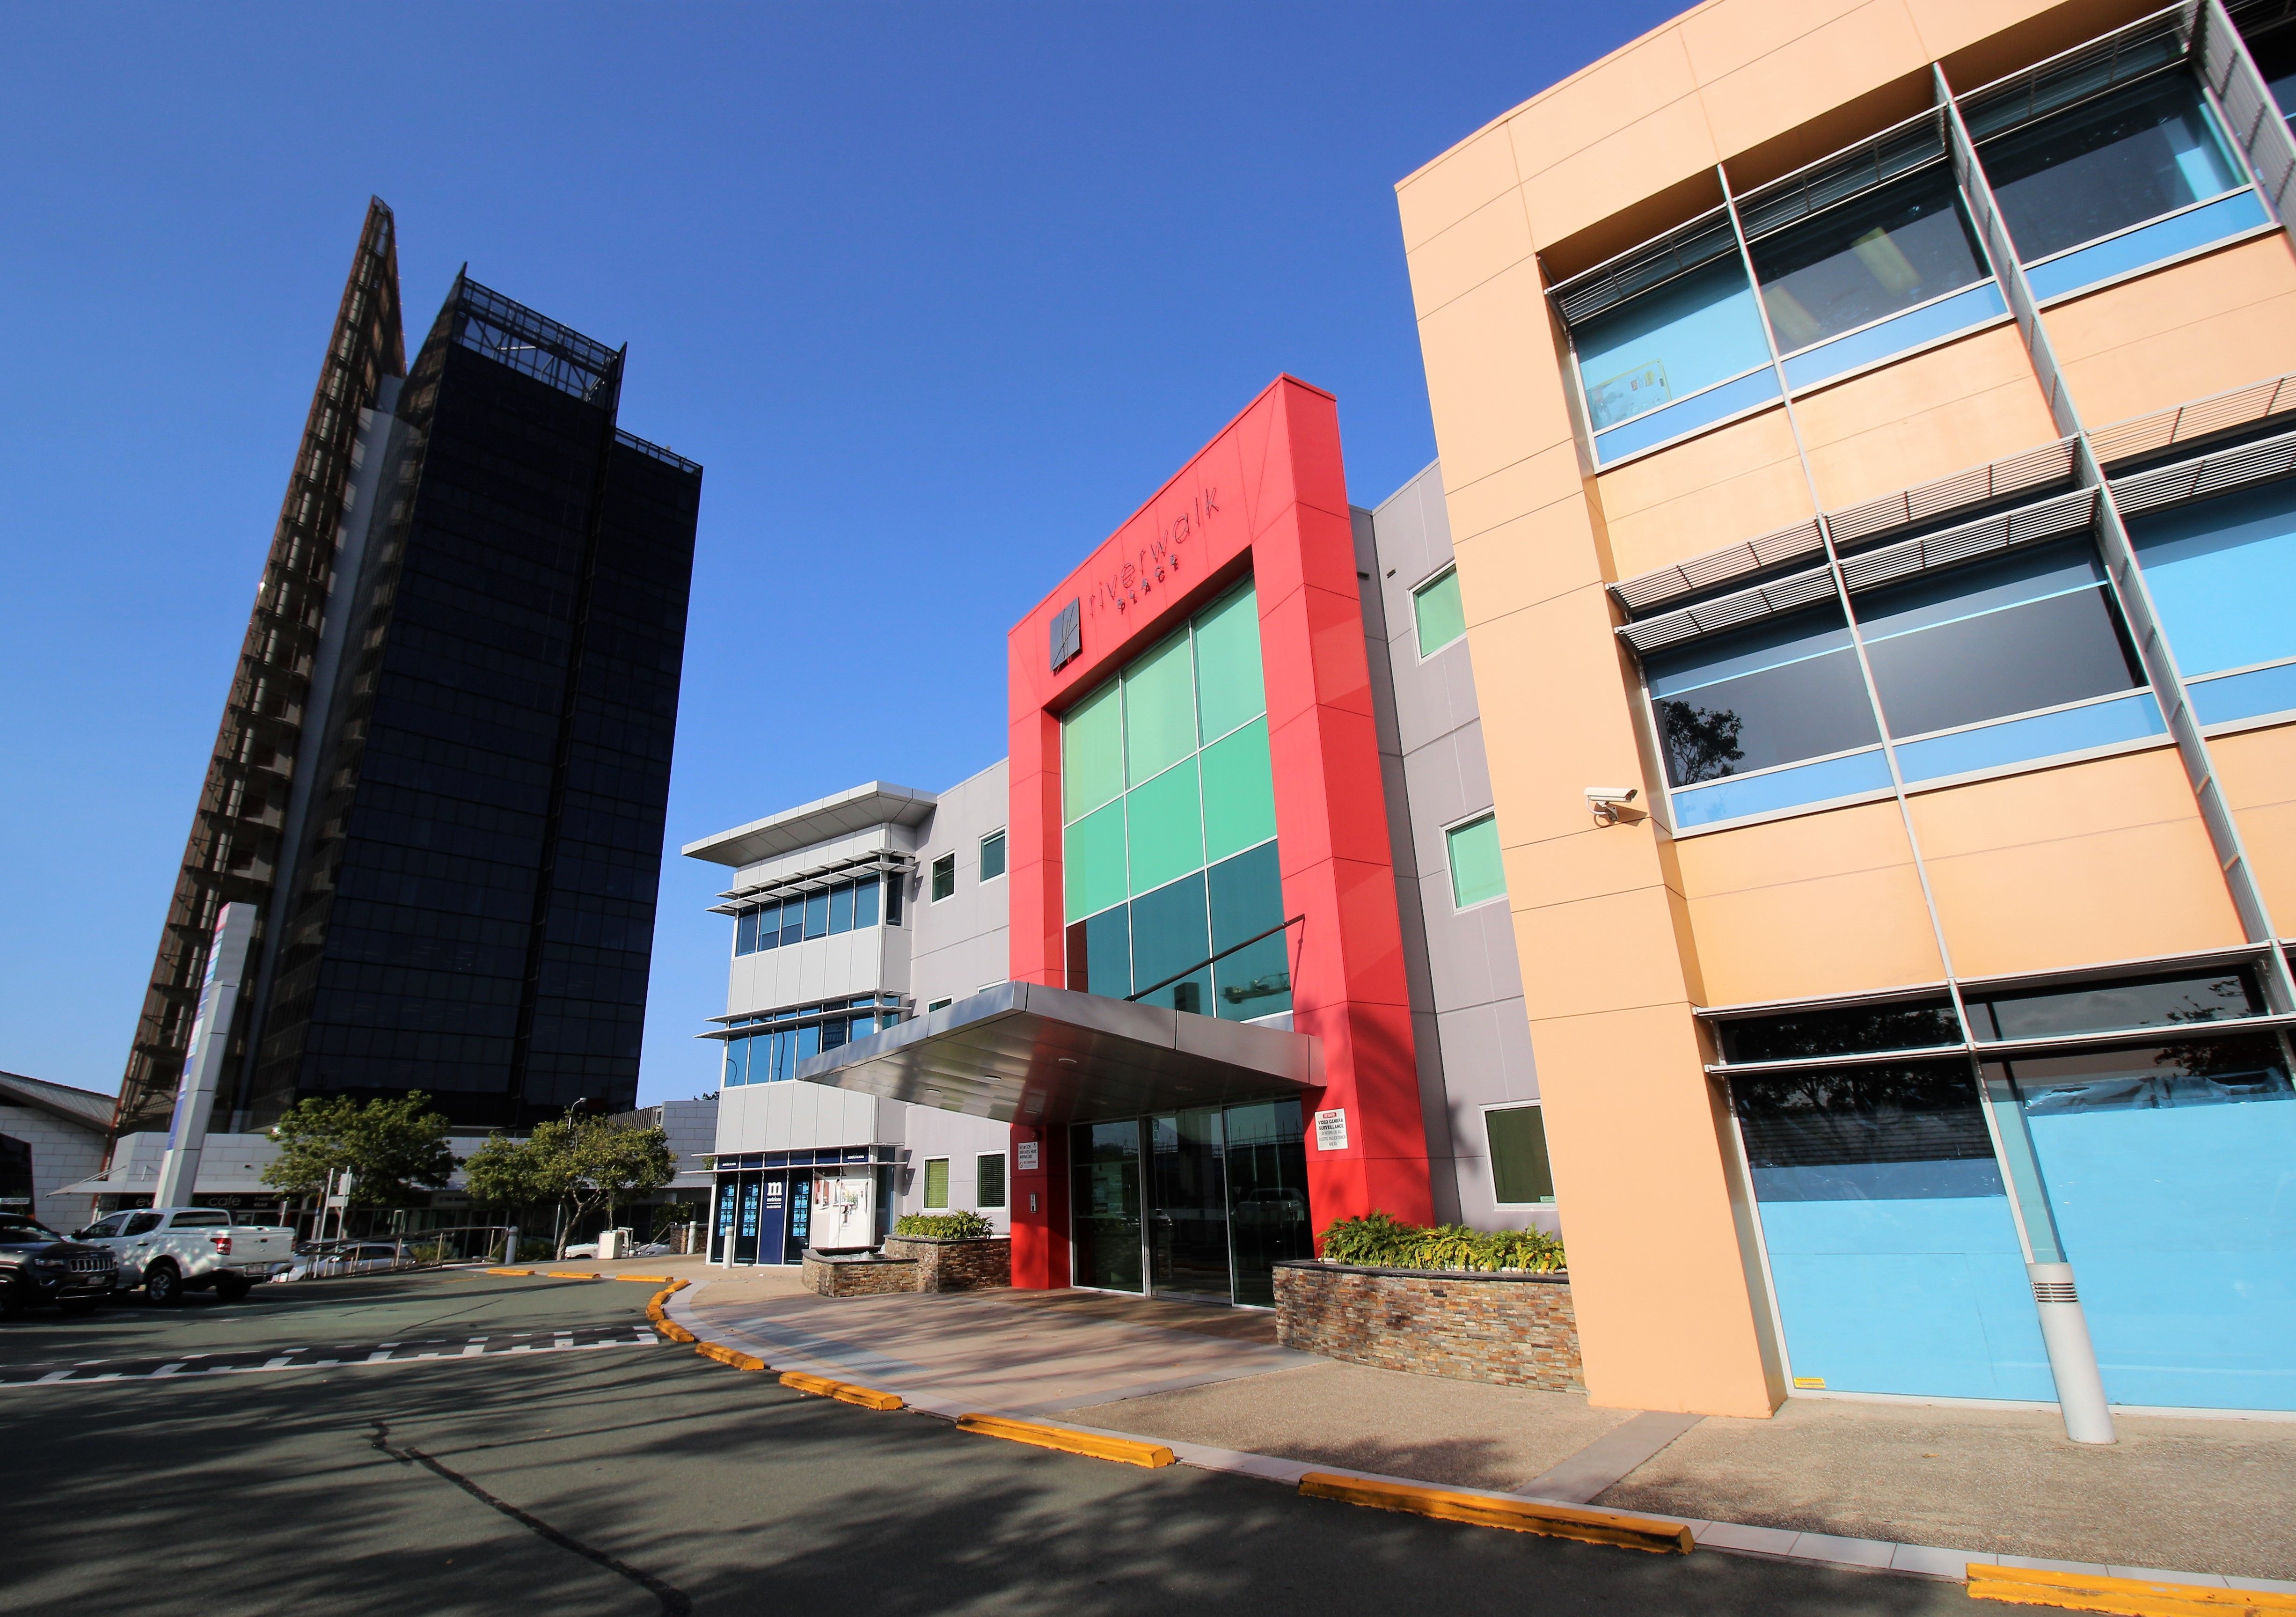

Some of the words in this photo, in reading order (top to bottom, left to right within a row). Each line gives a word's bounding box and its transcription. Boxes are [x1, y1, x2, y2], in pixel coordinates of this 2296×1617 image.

[1090, 487, 1219, 618] riverwalk
[1118, 554, 1177, 612] PLACE
[767, 1182, 782, 1196] m
